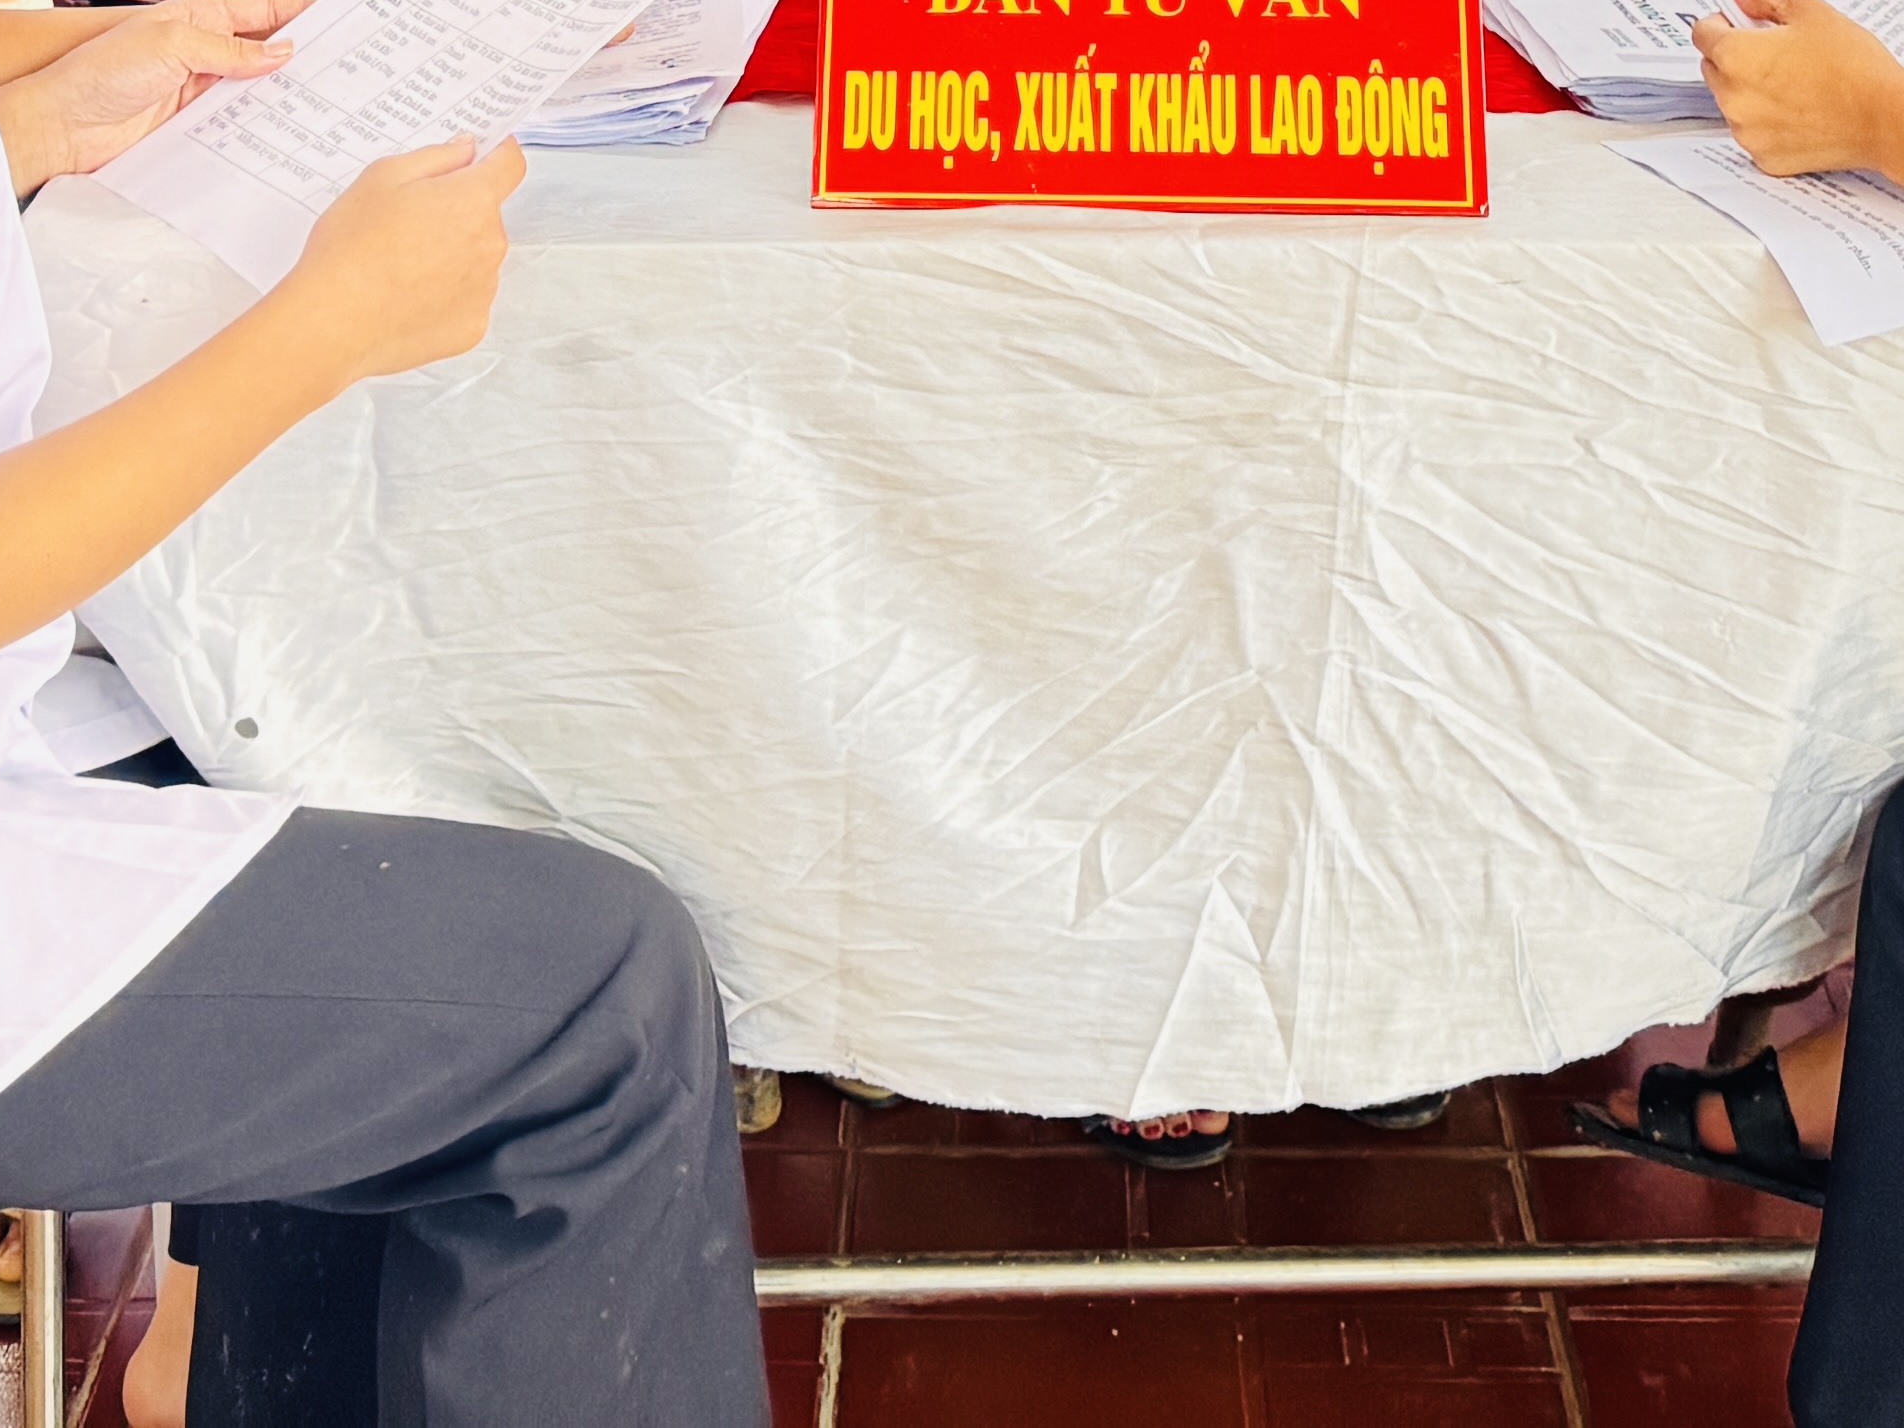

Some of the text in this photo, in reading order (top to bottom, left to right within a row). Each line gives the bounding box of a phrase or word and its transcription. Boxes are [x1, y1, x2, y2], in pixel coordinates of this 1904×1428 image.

[844, 41, 1448, 174] DU HỌC, XUẤT KHẨU LAO ĐỘNG
